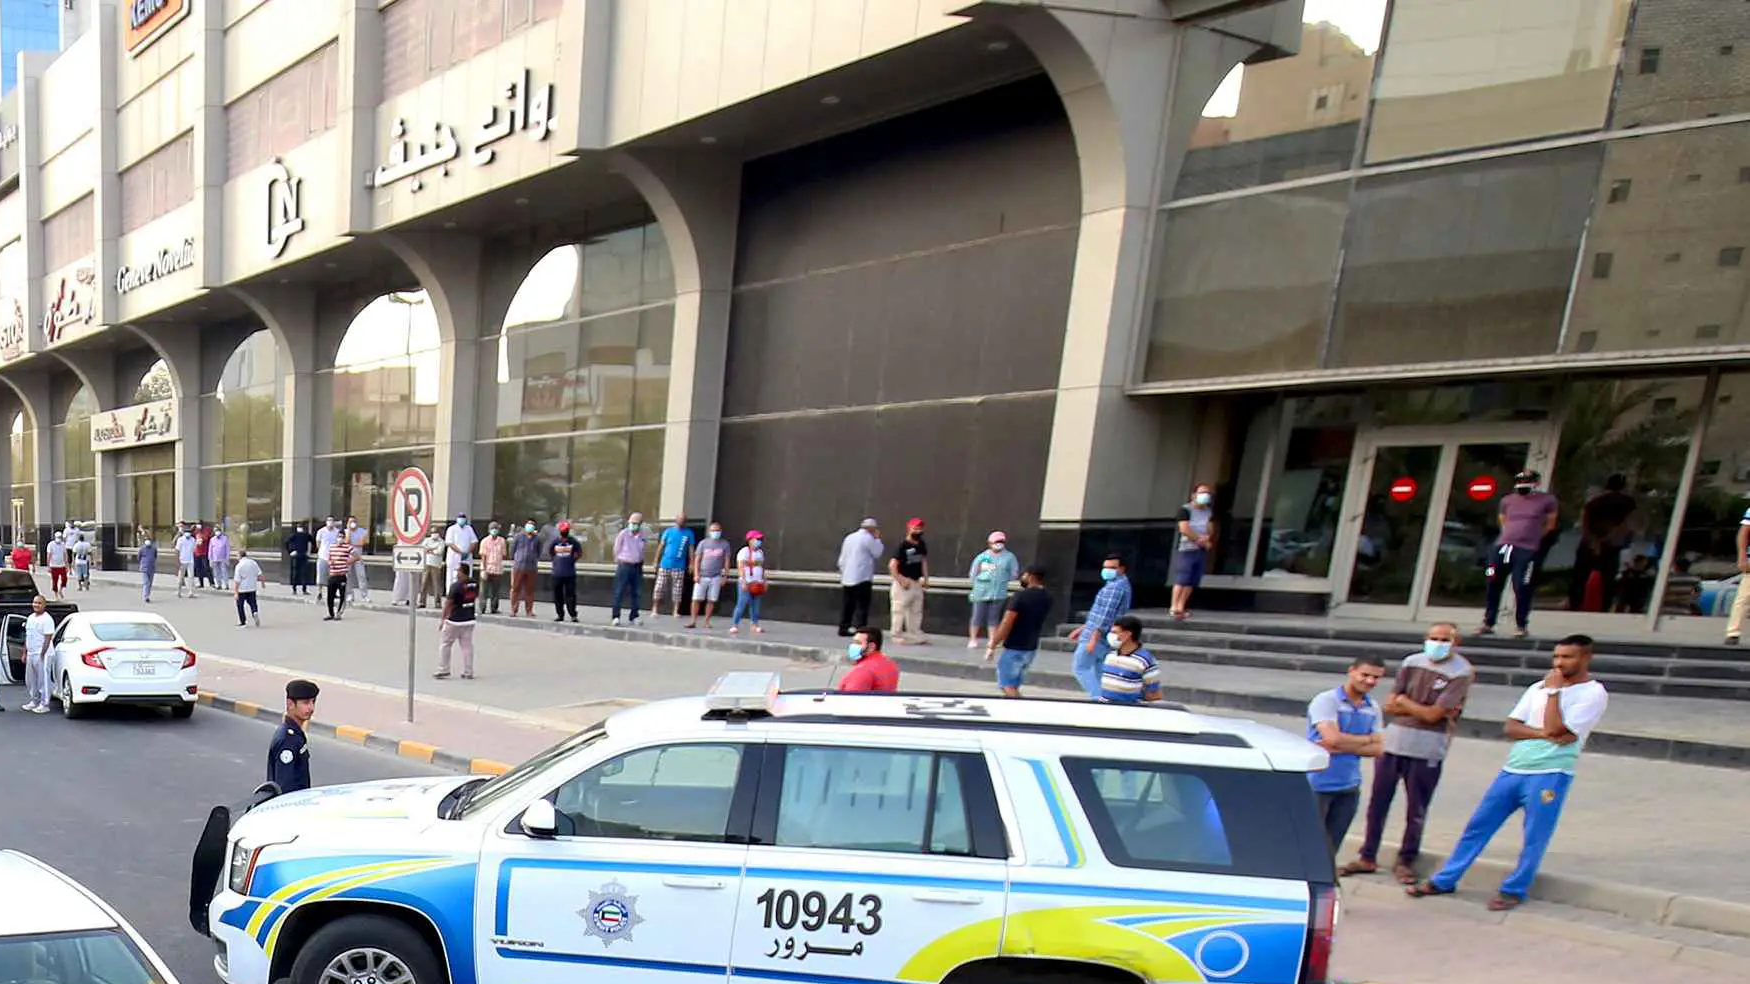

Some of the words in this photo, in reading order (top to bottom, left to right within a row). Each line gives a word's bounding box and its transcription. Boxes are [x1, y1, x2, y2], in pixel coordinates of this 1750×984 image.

[373, 117, 461, 193] جنيف
[115, 265, 153, 294] Geneve
[757, 888, 883, 936] 10943
[764, 936, 863, 960] مرور
